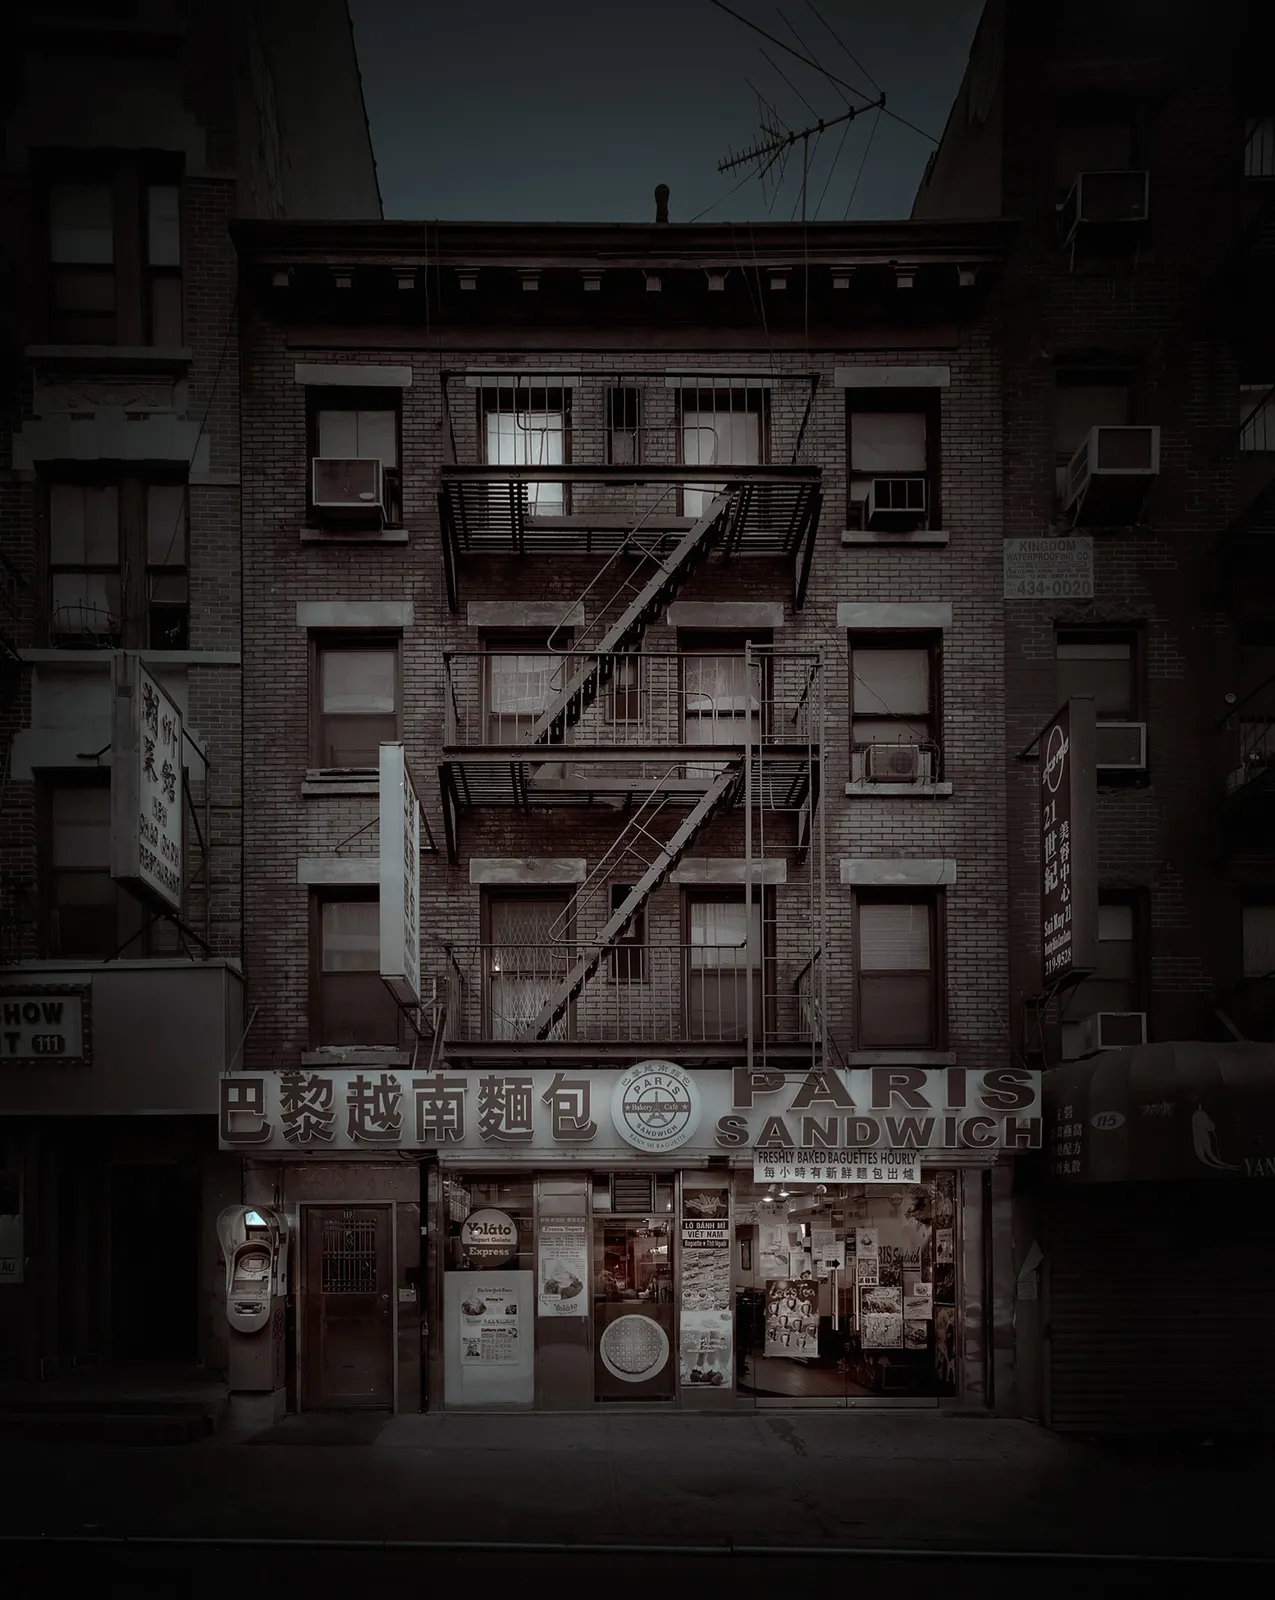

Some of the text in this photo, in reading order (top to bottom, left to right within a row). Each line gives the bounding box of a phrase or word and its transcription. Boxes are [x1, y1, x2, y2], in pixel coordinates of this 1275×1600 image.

[1020, 541, 1076, 551] KINGDOM
[1007, 552, 1074, 561] WATERPROOFING
[1018, 580, 1091, 596] 434-0020
[36, 1035, 59, 1052] 111
[633, 1076, 681, 1096] PARIS
[732, 1066, 1036, 1111] PARIS
[220, 1072, 598, 1144] 巴黎越南麵包
[631, 1103, 653, 1113] Bakery
[1096, 1114, 1117, 1127] 115
[636, 1123, 678, 1138] SANDWICH
[714, 1115, 1044, 1149] SANDWICH
[758, 1151, 917, 1165] FRESHLY BAKED BAGUETTES HOURLY
[466, 1222, 512, 1236] Yoláto
[468, 1247, 510, 1258] Express
